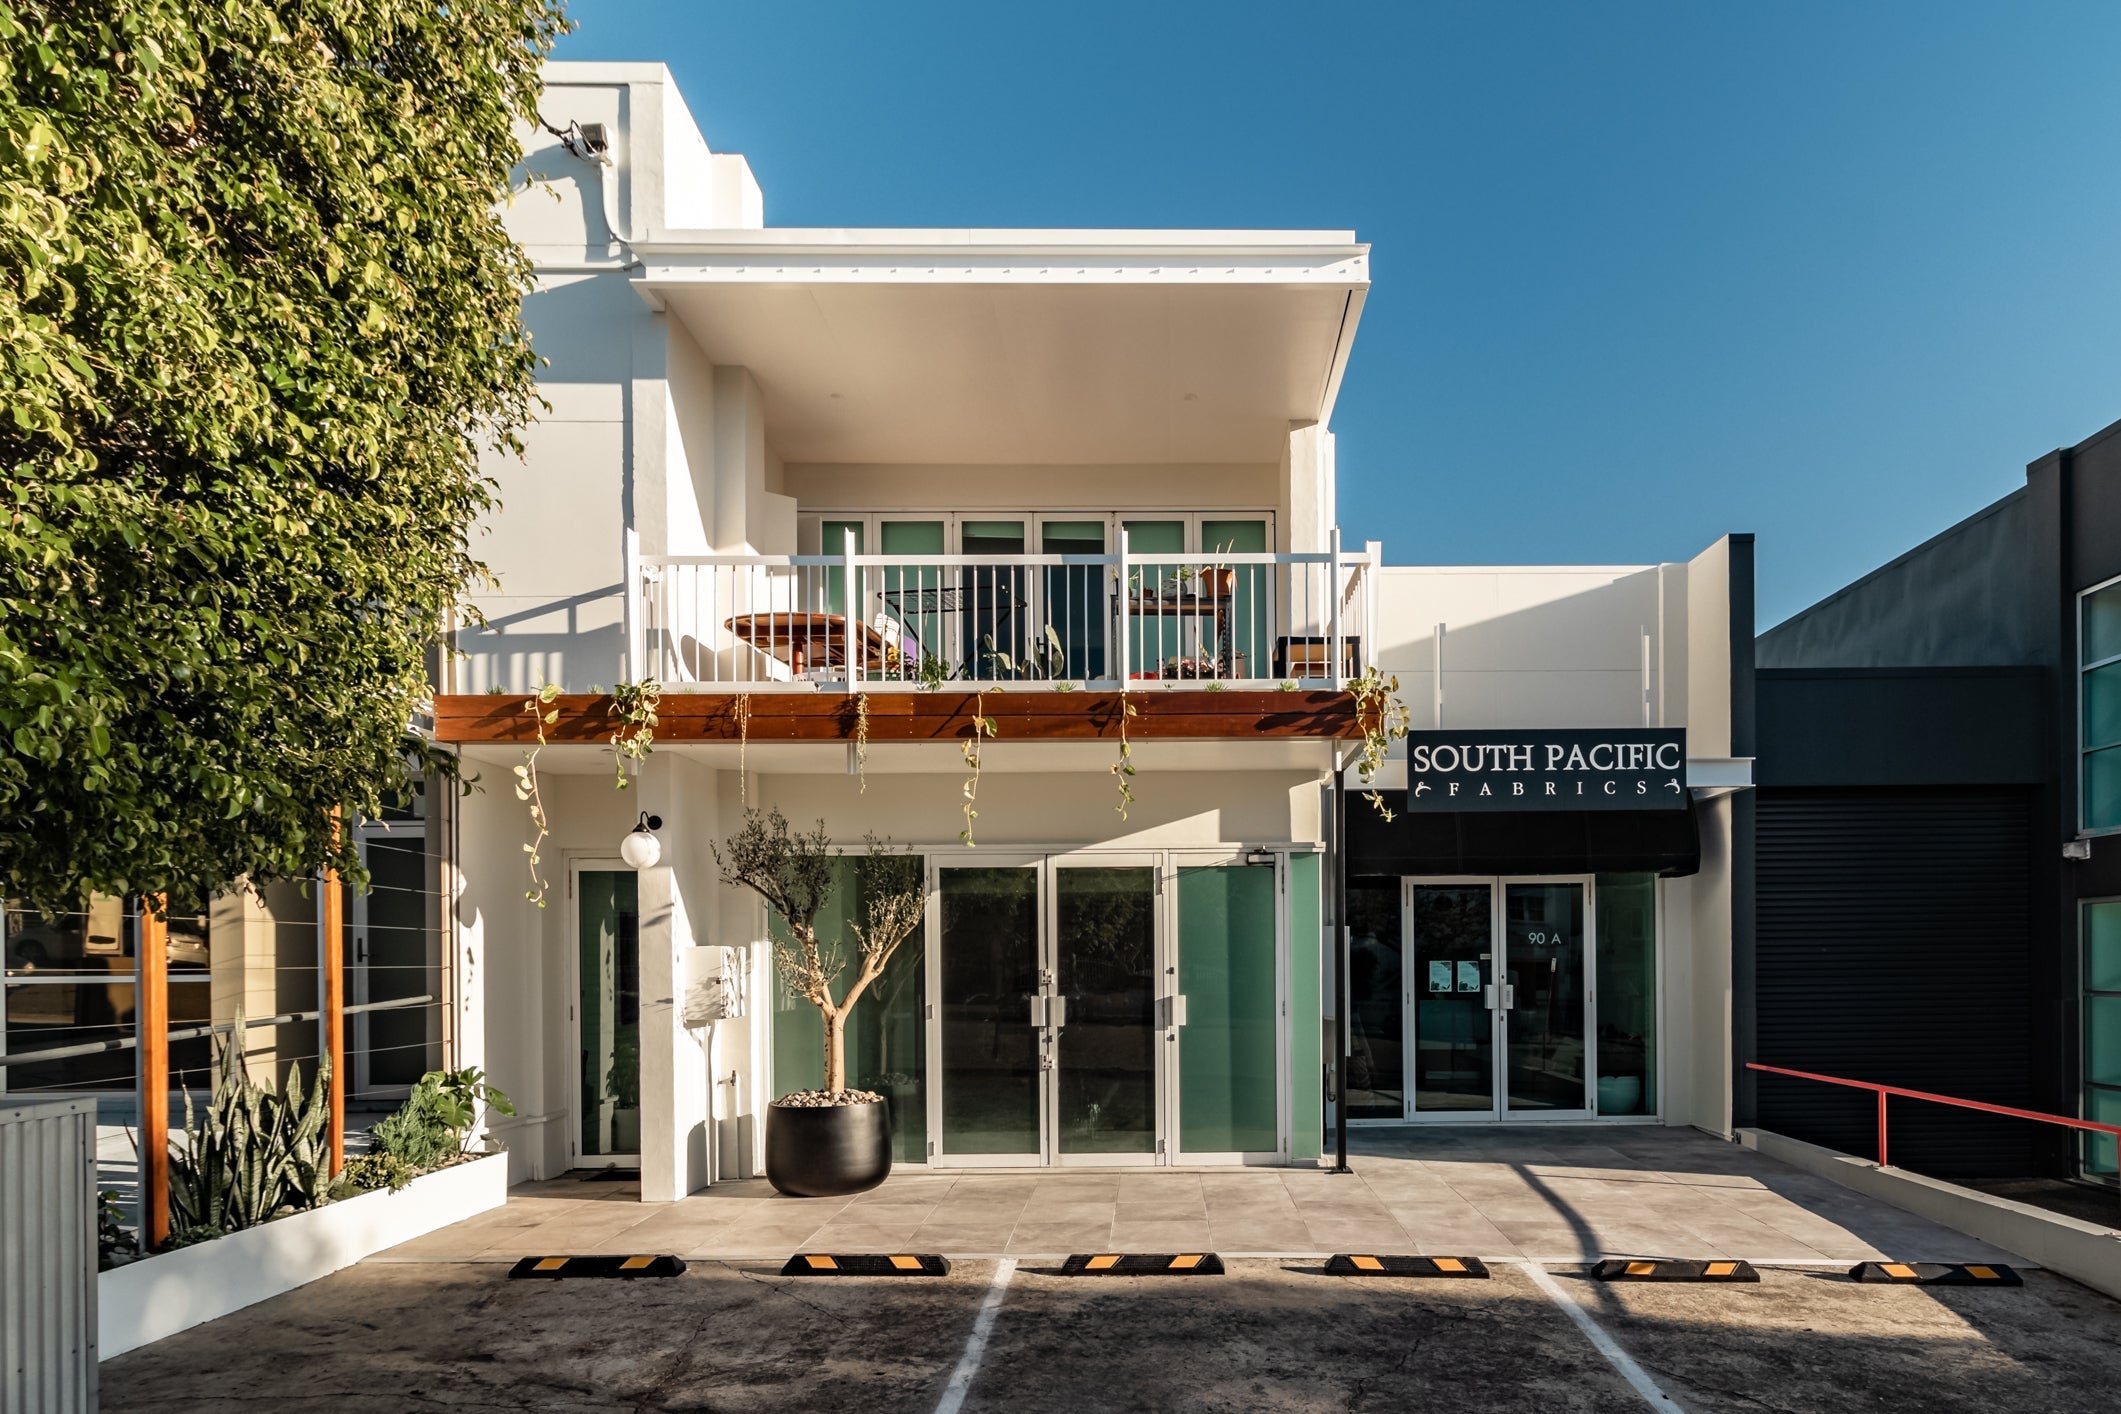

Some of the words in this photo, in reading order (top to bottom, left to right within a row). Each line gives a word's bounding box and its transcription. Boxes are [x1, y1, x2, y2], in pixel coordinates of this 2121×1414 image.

[1413, 744, 1535, 773] SOUTH
[1545, 743, 1681, 771] PACIFIC
[1448, 780, 1647, 796] FABRICS
[1528, 932, 1546, 945] 90
[1551, 933, 1562, 945] A
